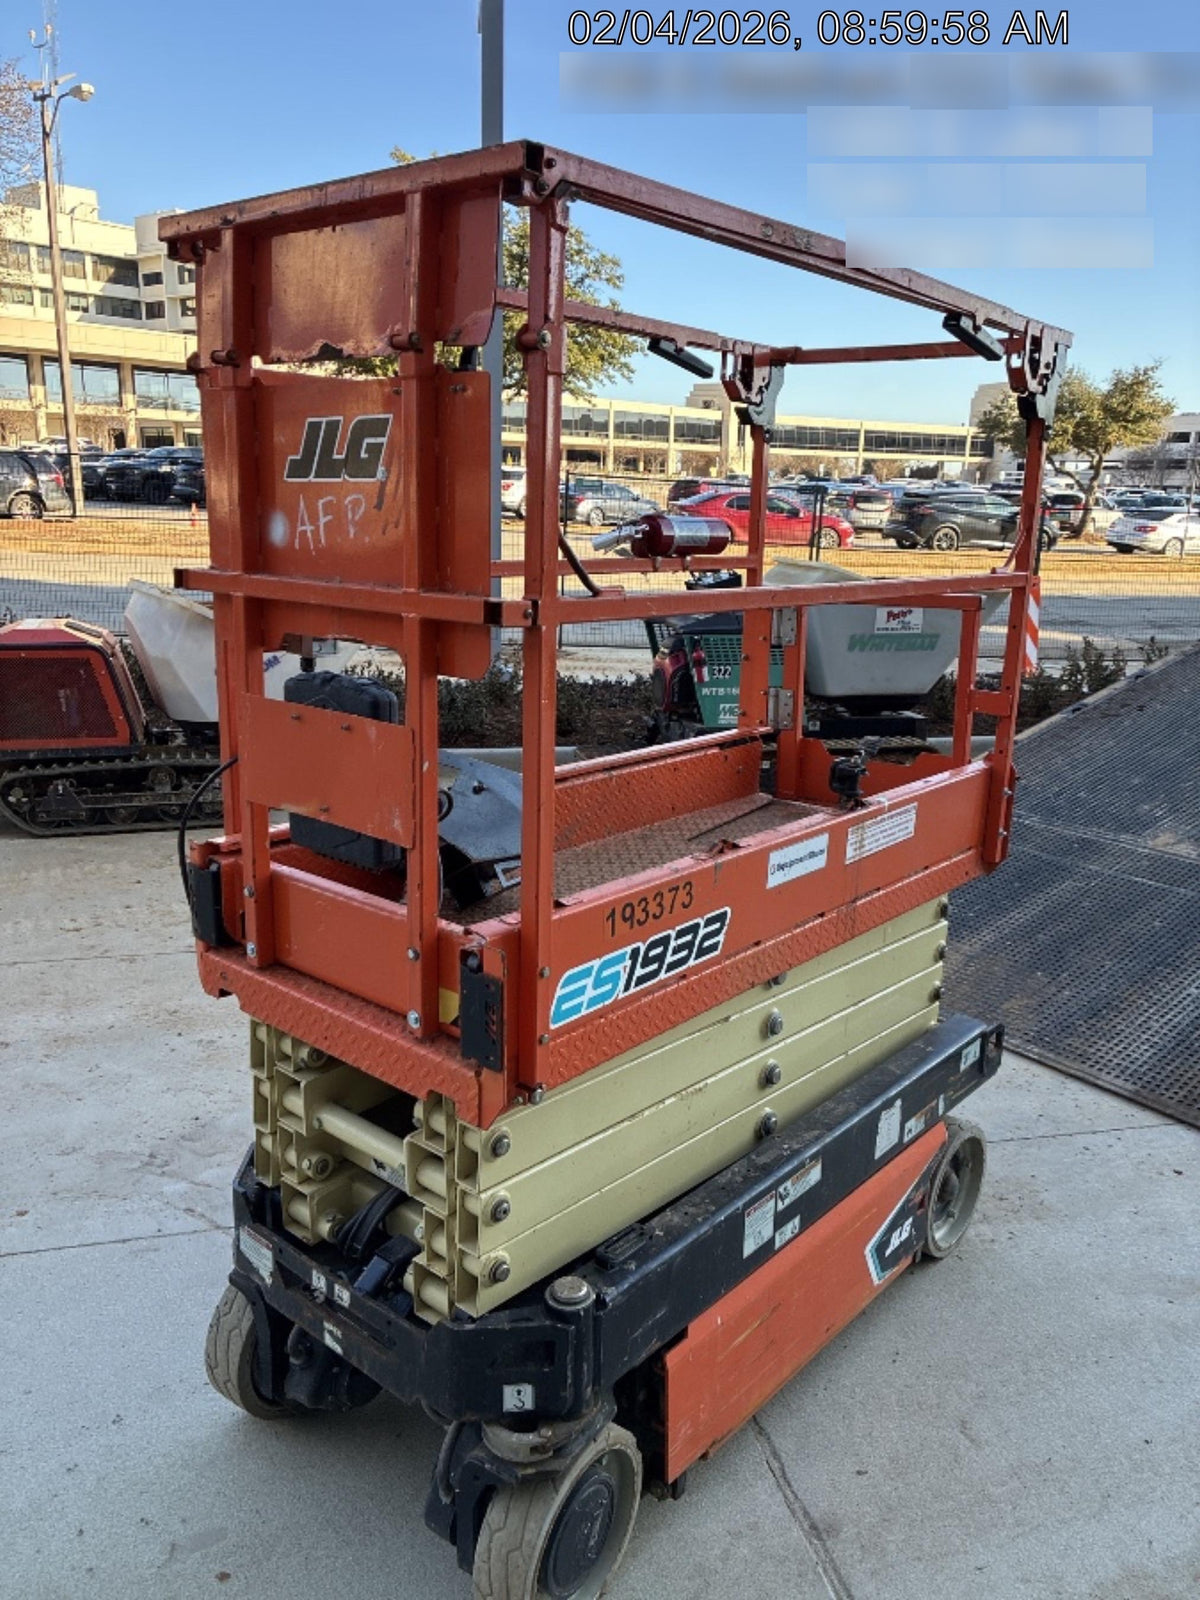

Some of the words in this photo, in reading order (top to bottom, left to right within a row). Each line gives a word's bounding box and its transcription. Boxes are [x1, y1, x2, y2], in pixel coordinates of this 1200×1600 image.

[284, 414, 393, 481] JLG
[849, 634, 940, 652] WHITEMAN
[712, 666, 731, 679] 322
[605, 882, 693, 937] 193373
[550, 907, 731, 1028] ES1932
[886, 1217, 913, 1256] JLG
